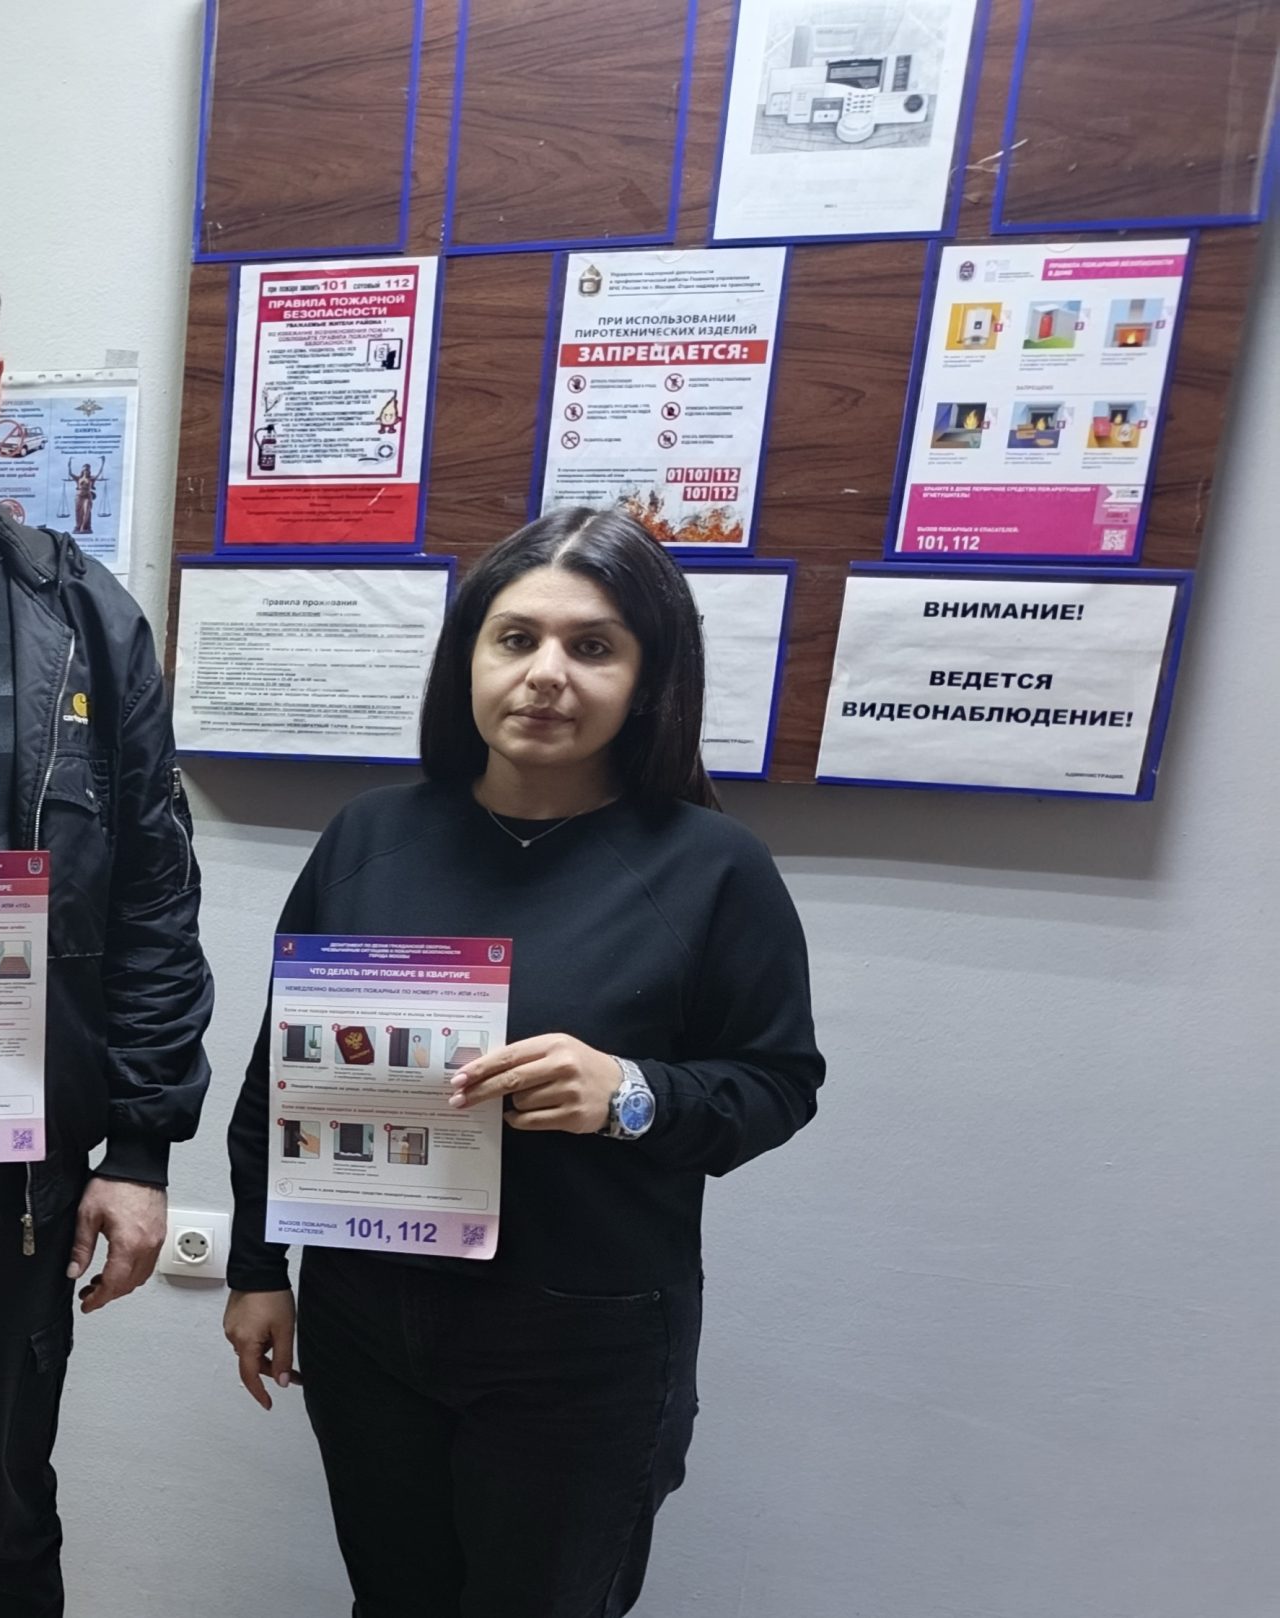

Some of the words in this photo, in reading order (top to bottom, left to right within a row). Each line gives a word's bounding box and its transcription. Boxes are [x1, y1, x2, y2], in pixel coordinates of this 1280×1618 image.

[321, 280, 347, 291] 101
[385, 279, 410, 288] 112
[268, 297, 327, 309] ПРАВИЛА
[330, 294, 405, 306] ПОЖАРНОЙ
[283, 307, 387, 319] БЕЗОПАСНОСТИ
[597, 316, 623, 326] ПРИ
[625, 314, 736, 325] ИСПОЛЬЗОВАНИИ
[574, 326, 695, 338] ПИРОТЕХНИЧЕСКИХ
[698, 323, 757, 336] ИЗДЕЛИЙ
[577, 344, 749, 364] ЗАПРЕЩАЕТСЯ:
[667, 468, 683, 482] 01
[688, 468, 710, 482] 101
[715, 468, 739, 482] 112
[685, 487, 708, 500] 101
[712, 487, 736, 500] 112
[917, 535, 948, 552] 101,
[952, 535, 980, 550] 112
[262, 598, 300, 608] Правила
[302, 599, 358, 609] проживания
[922, 601, 1084, 621] ВНИМАНИЕ!
[929, 670, 1053, 691] ВЕДЕТСЯ
[841, 701, 1134, 728] ВИДЕОНАБЛЮДЕНИЕ!
[309, 967, 326, 975] ЧТО
[327, 968, 360, 977] ДЕЛАТЬ
[380, 969, 417, 978] ПОЖАРЕ
[426, 971, 471, 979] КВАРТИРЕ
[285, 985, 327, 993] НЕМЕДЛЕННО
[364, 987, 400, 995] ПОЖАРНЫХ
[279, 1219, 300, 1227] ВЫЗОВ
[302, 1221, 338, 1229] ПОЖАРНЫХ
[346, 1217, 391, 1243] 101,
[398, 1221, 438, 1243] 112
